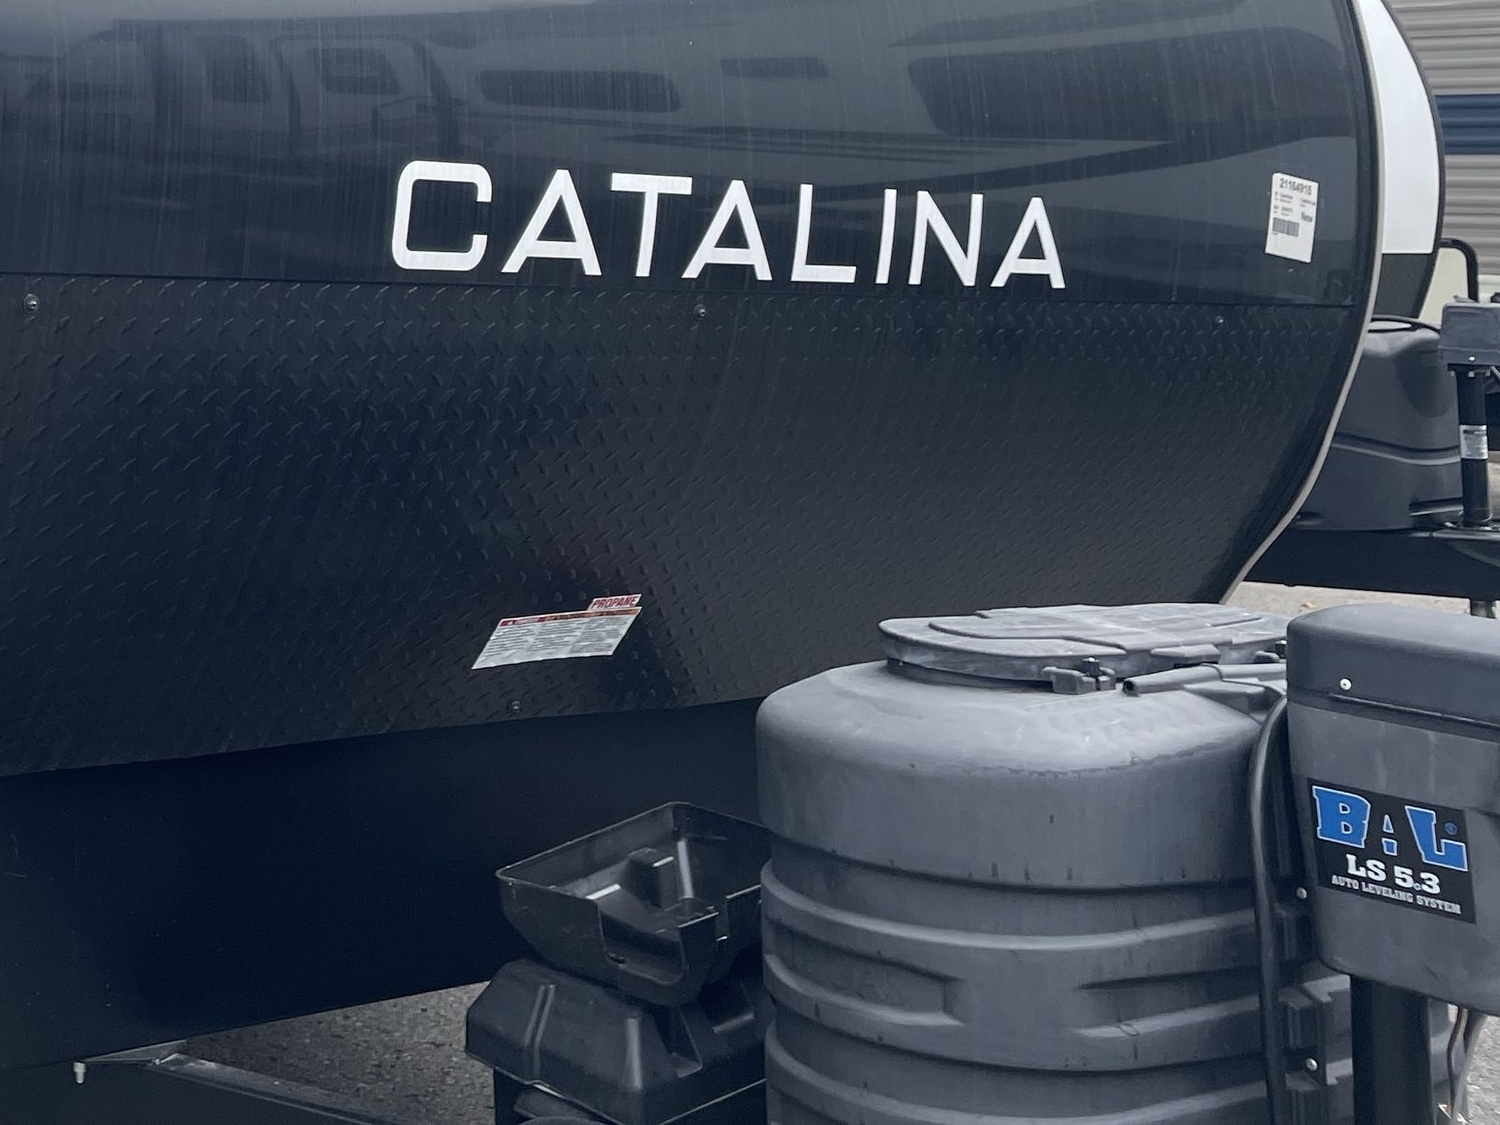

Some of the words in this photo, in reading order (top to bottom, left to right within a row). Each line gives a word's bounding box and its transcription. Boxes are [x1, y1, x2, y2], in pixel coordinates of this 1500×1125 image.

[392, 160, 1066, 289] CATALINA
[591, 595, 638, 609] PROPANE
[1312, 785, 1468, 872] BAL
[1331, 875, 1359, 890] AUTO
[1361, 881, 1414, 903] LEVELING
[1416, 894, 1462, 915] SYSTEM
[1345, 853, 1387, 882] LS
[1393, 865, 1441, 895] 5.3
